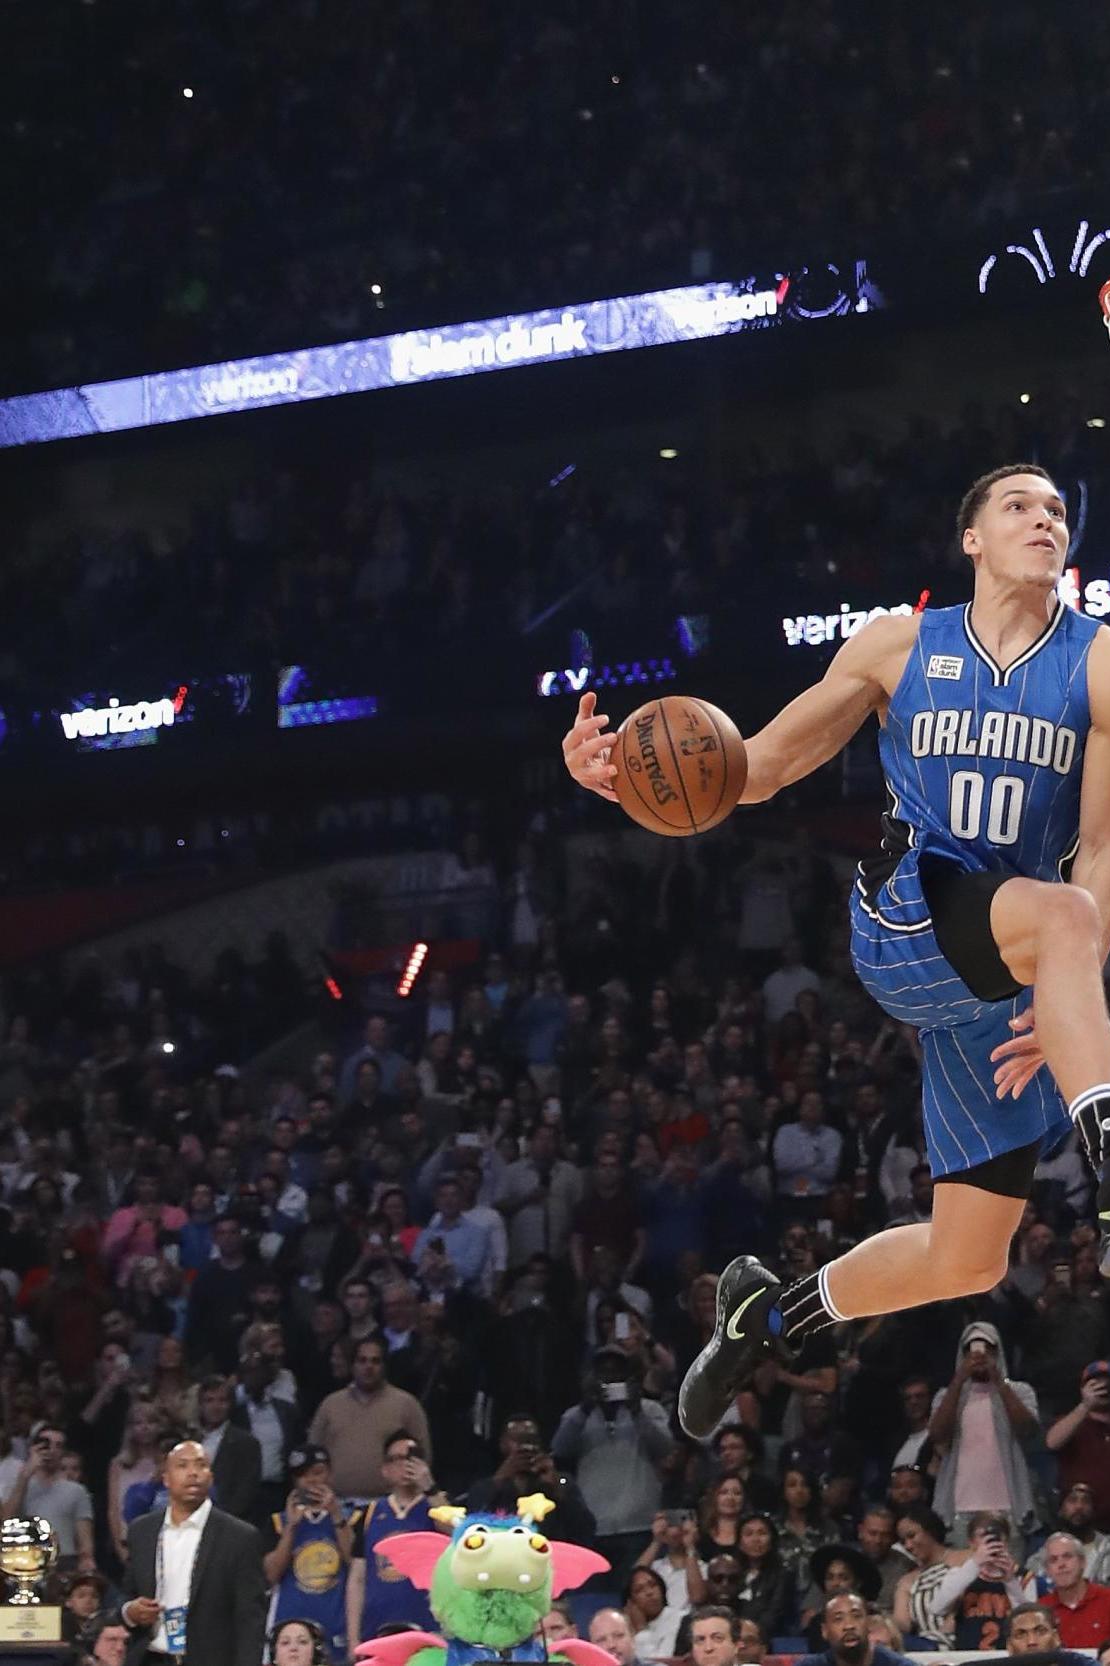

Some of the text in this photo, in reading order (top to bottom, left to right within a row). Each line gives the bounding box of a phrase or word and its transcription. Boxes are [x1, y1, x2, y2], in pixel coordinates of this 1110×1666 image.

[496, 312, 588, 363] dunk
[61, 698, 174, 739] verizon
[912, 710, 1077, 776] ORLANDO
[634, 710, 678, 806] SPALDING
[950, 770, 1025, 845] 00
